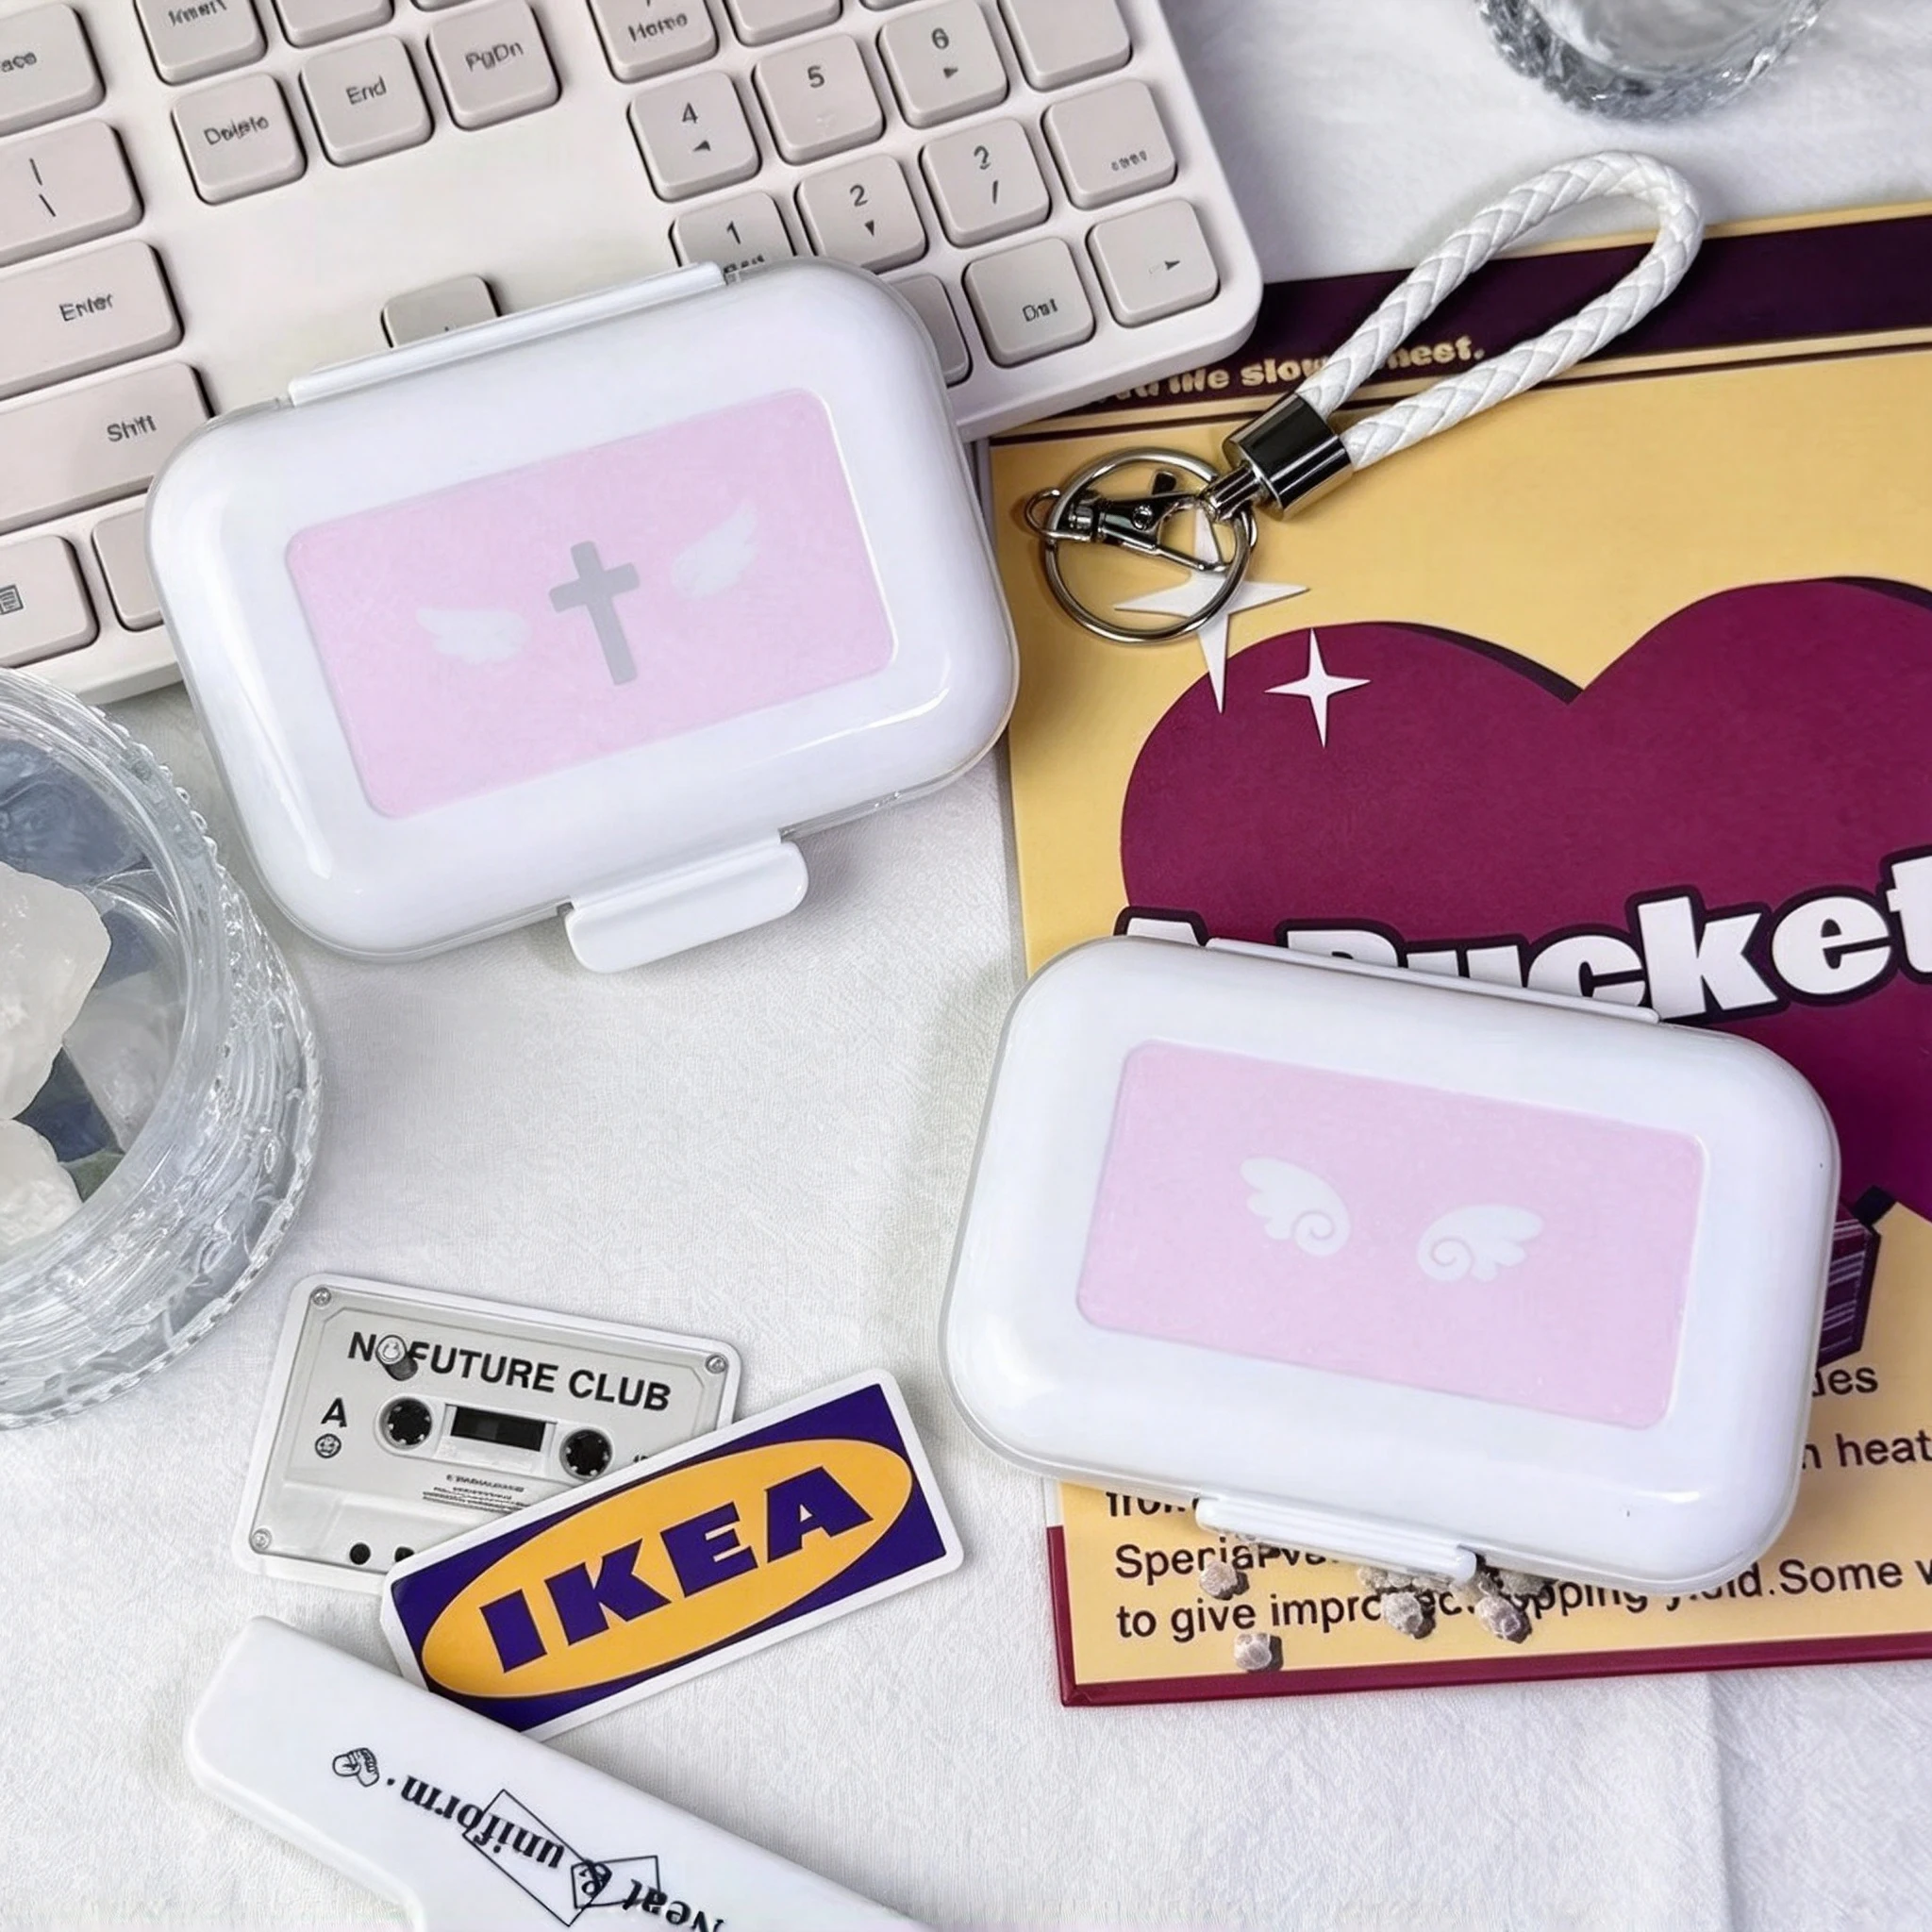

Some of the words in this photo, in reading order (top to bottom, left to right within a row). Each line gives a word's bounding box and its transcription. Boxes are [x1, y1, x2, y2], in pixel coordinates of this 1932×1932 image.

[932, 26, 950, 51] 6
[464, 38, 525, 72] PgDn
[346, 76, 389, 106] End
[808, 63, 825, 90] 5
[680, 101, 699, 126] 4
[849, 183, 869, 208] 2
[725, 220, 742, 245] 1
[58, 291, 114, 323] Enter
[107, 413, 158, 443] Shift
[408, 1341, 559, 1394] FUTURE
[567, 1368, 673, 1413] CLUB
[320, 1397, 348, 1429] A
[479, 1466, 874, 1674] IKEA
[1116, 1605, 1158, 1639] to
[1170, 1597, 1257, 1642] give
